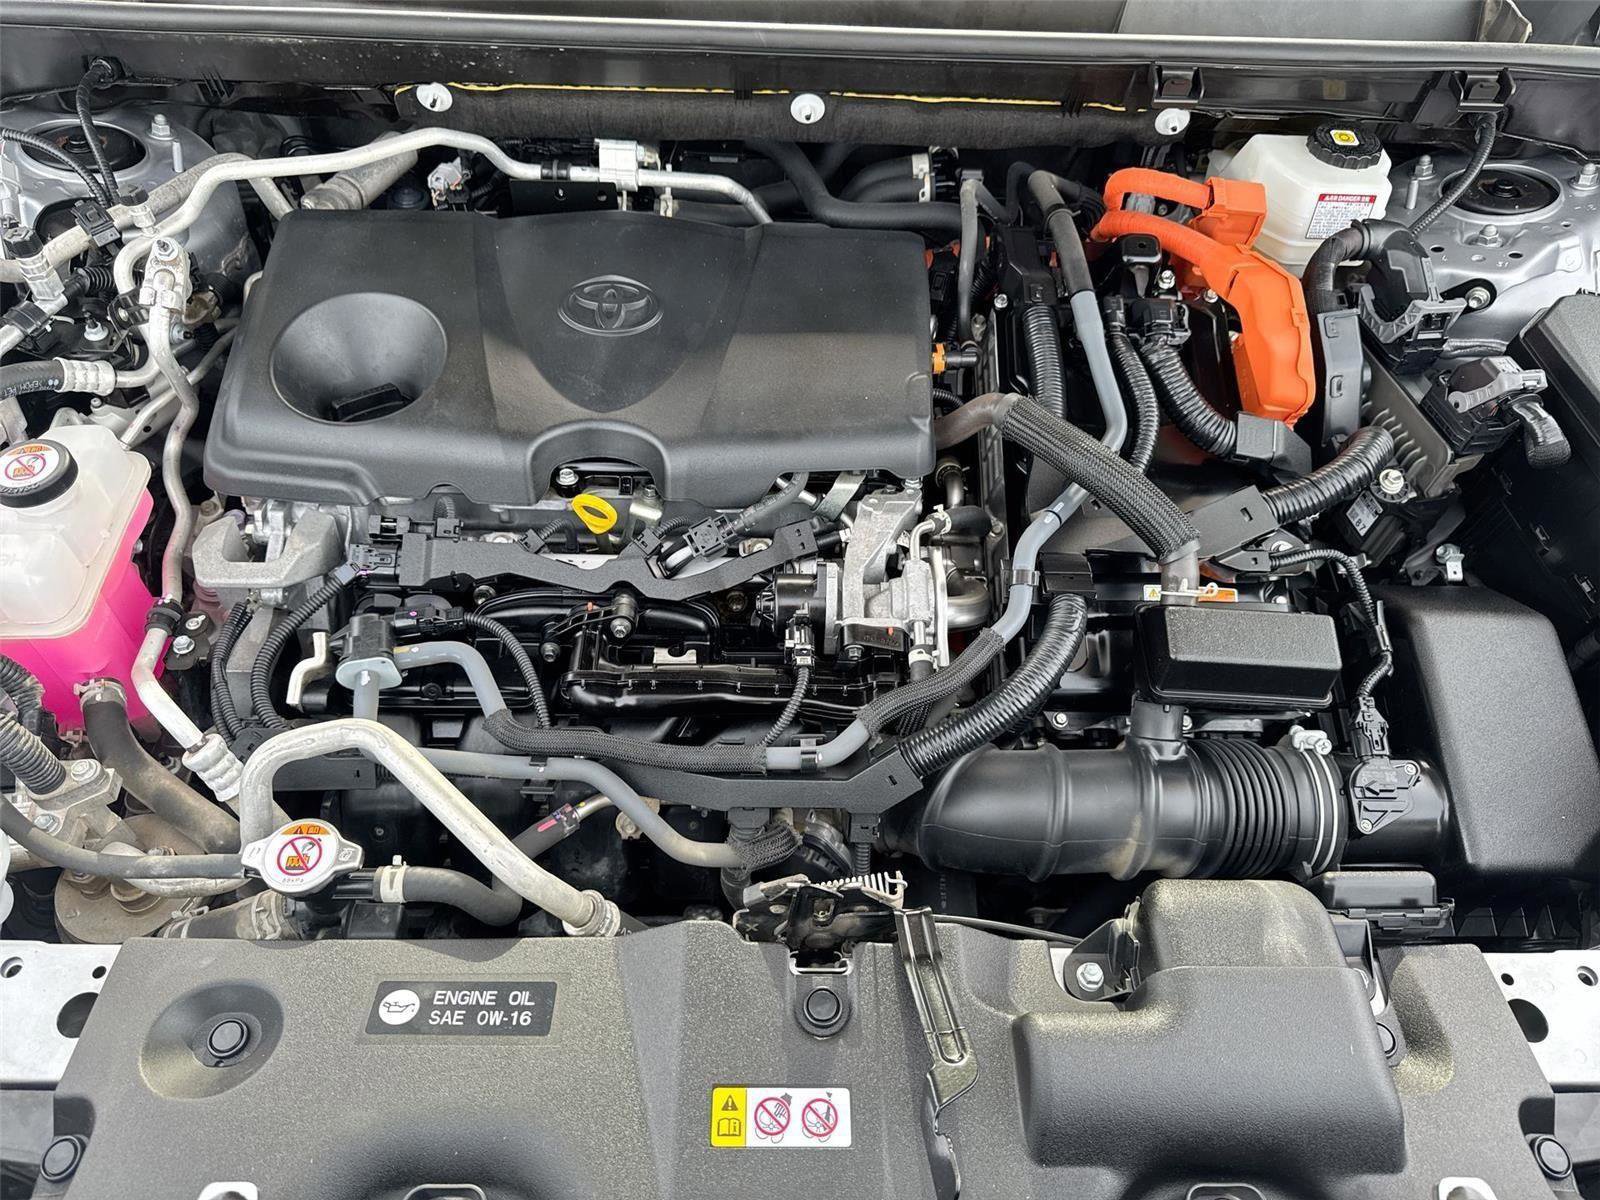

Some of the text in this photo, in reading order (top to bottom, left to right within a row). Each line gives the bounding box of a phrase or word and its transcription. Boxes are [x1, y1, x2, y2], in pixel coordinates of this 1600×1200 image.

[433, 990, 535, 1006] ENGINE OIL
[428, 1010, 532, 1026] SAE 0W-16
